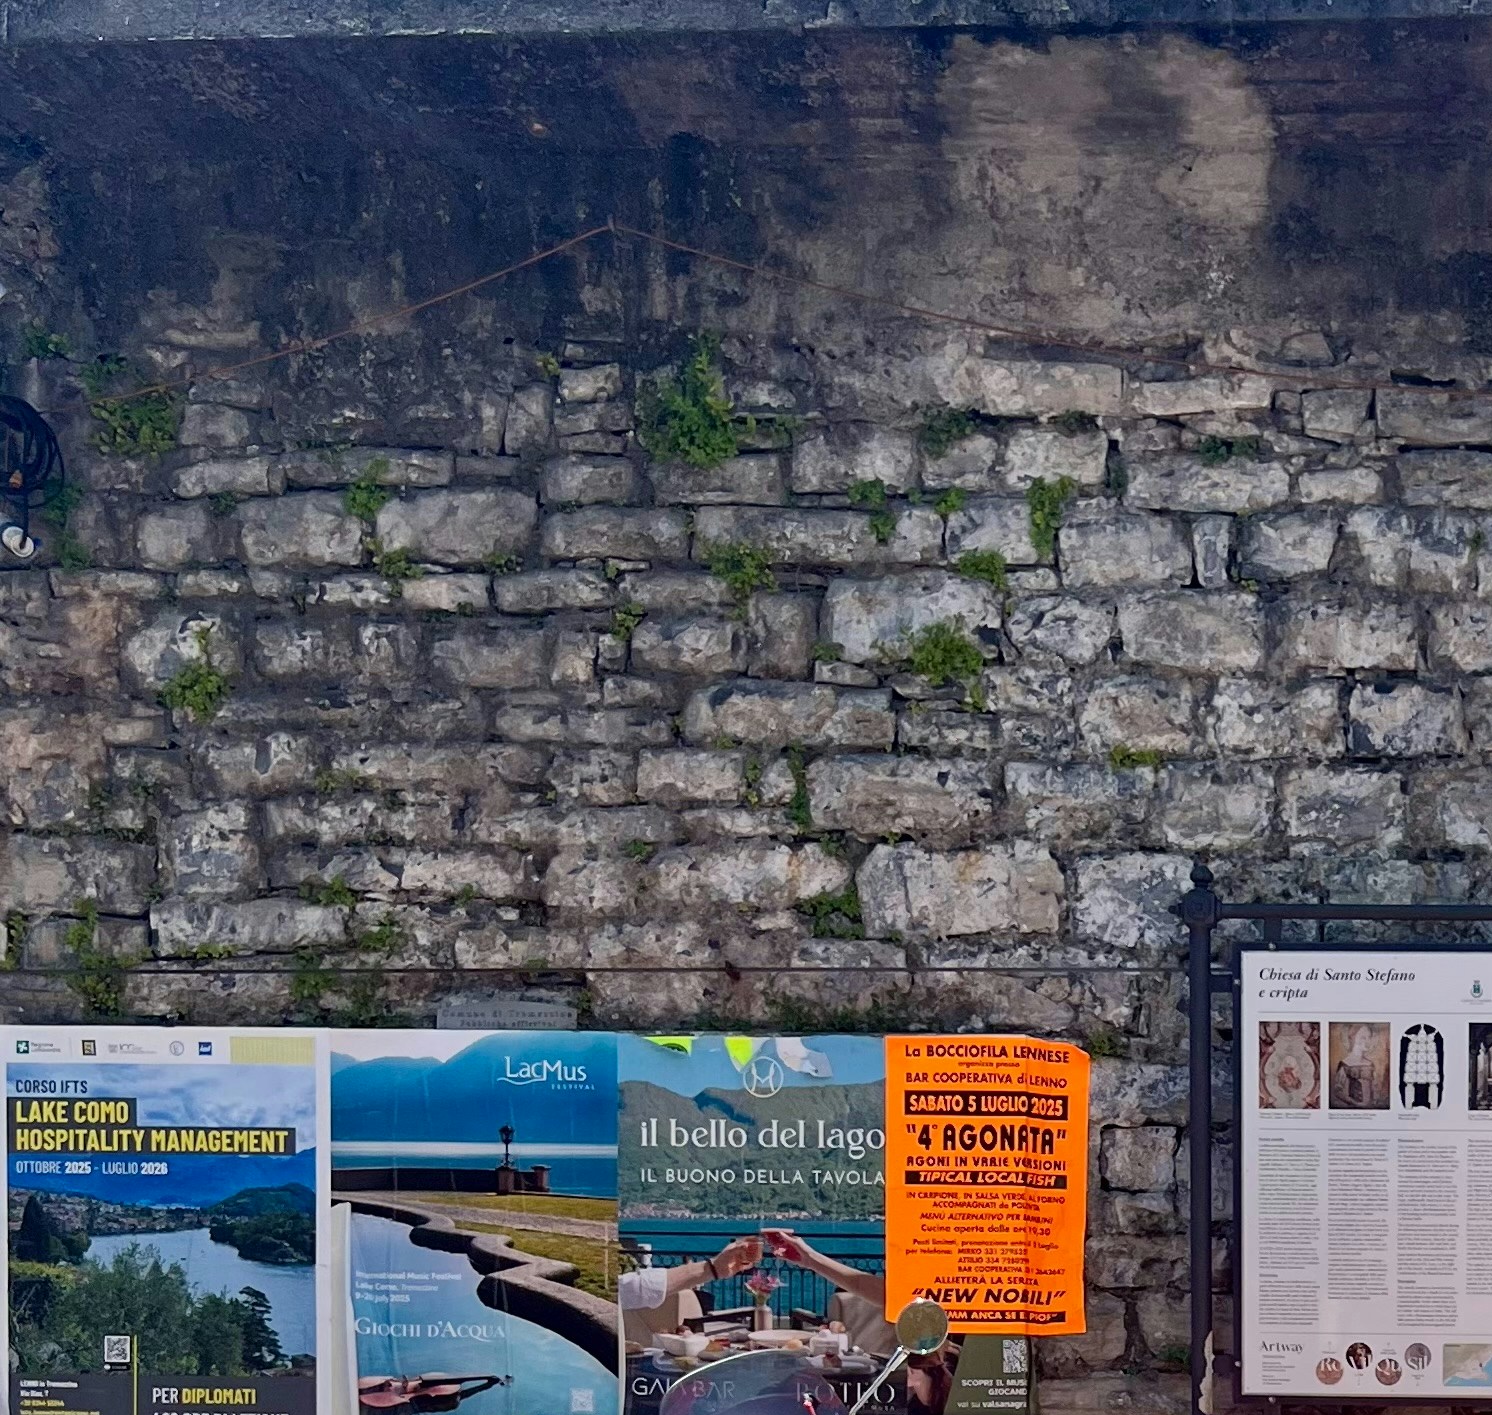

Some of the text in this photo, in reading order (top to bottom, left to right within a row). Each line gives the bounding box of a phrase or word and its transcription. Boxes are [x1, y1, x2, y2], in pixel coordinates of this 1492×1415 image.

[1259, 967, 1416, 986] Chiesa di Santo Stefano
[1259, 986, 1309, 1001] e cripta
[905, 1044, 1070, 1063] La BOCCIOFILA LENNESE
[503, 1056, 587, 1082] LacMus
[16, 1080, 88, 1094] CORSO IFTS
[906, 1073, 929, 1083] BAR
[933, 1073, 1013, 1084] COOPERATIVA
[1029, 1075, 1068, 1088] LENNO
[16, 1101, 129, 1124] LAKE COMO
[909, 1094, 1063, 1117] SABATO 5 LUGLIO 2025
[16, 1129, 289, 1153] HOSPITALITY MANAGEMENT
[640, 1118, 886, 1160] il bello del lago
[16, 1161, 62, 1174] OTTOBRE
[64, 1162, 92, 1174] 2025
[102, 1162, 139, 1175] LUGLIO
[906, 1156, 1067, 1171] AGONI IN VARIE VERSIONI
[641, 1168, 885, 1185] IL BUONO DELLA TAVOLA
[919, 1171, 1057, 1187] TIPICAL LOCAL FISH
[976, 1192, 999, 1200] SALSA
[932, 1201, 997, 1209] ACCOMPAGNATI
[948, 1213, 1003, 1221] ALTERNATIVO
[1006, 1213, 1021, 1221] PER
[921, 1224, 951, 1232] Cucina
[954, 1225, 984, 1234] aperta
[988, 1223, 1010, 1232] dalle
[354, 1317, 421, 1338] GIOCHI
[1259, 1340, 1304, 1355] Artway
[152, 1388, 256, 1405] PER DIPLOMATI
